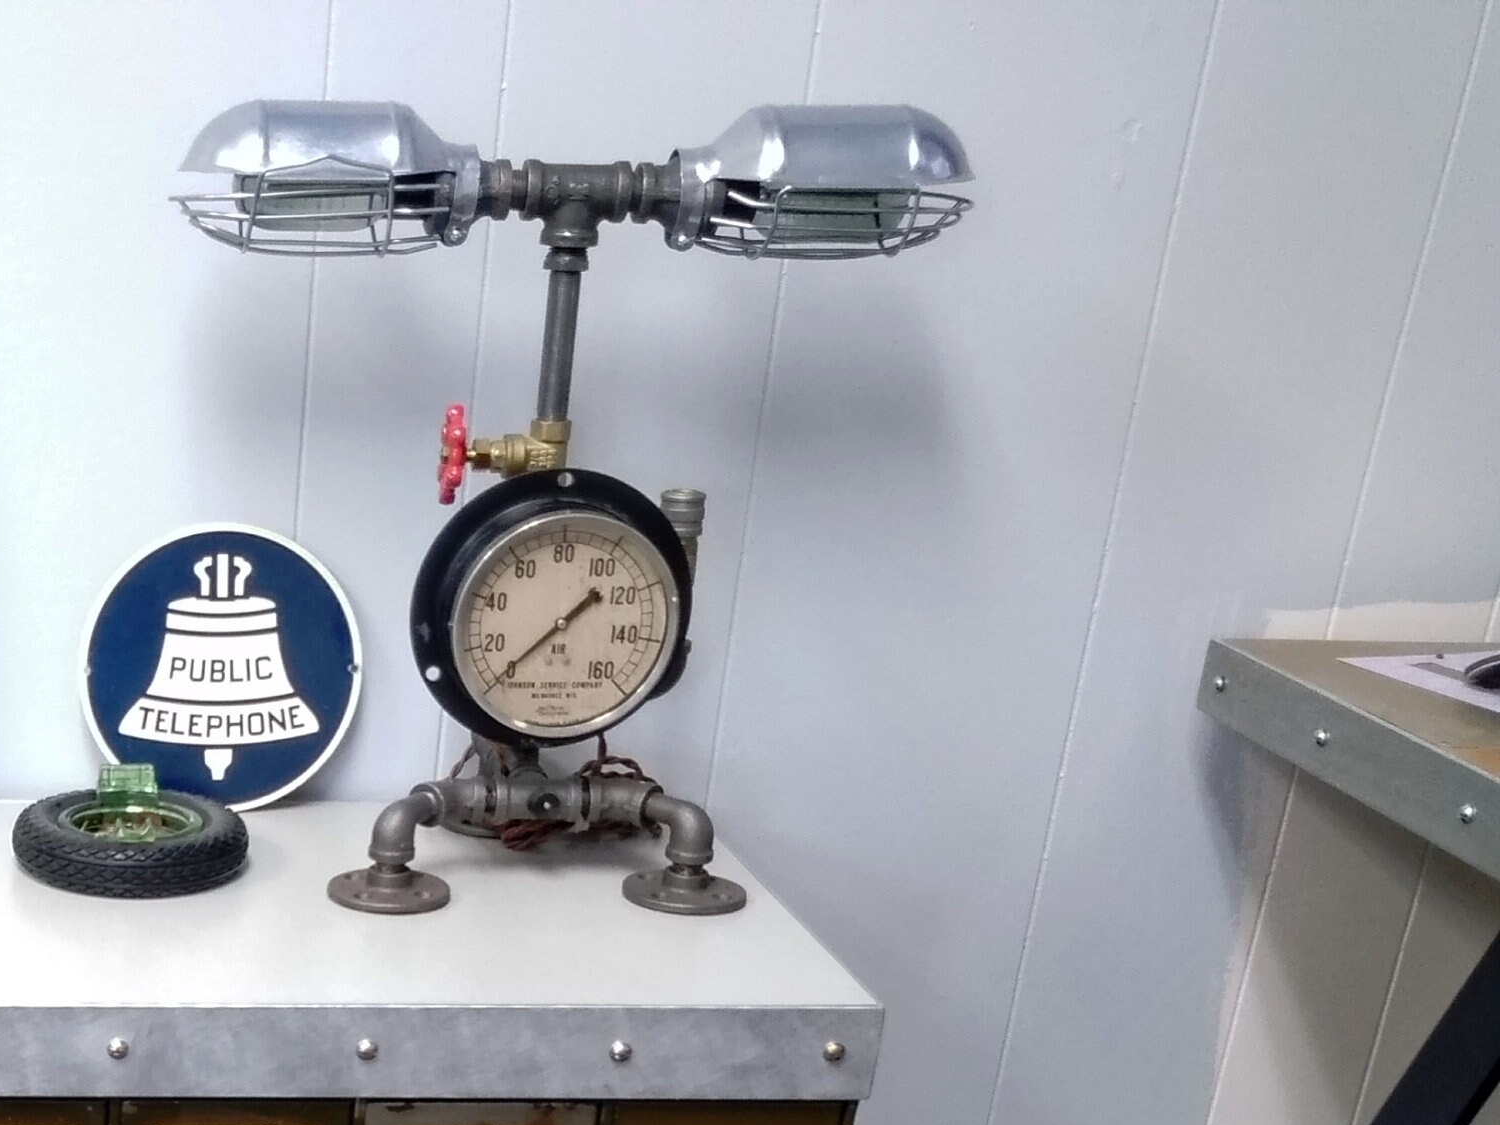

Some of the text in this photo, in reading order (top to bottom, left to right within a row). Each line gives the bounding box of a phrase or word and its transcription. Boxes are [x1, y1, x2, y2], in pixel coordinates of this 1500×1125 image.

[553, 544, 575, 563] 80
[514, 559, 536, 578] 60
[588, 558, 616, 577] 100
[485, 592, 508, 612] 40
[609, 586, 636, 605] 120
[484, 633, 505, 653] 20
[610, 625, 638, 644] 140
[550, 643, 567, 655] AIR
[169, 656, 273, 683] PUBLIC
[506, 660, 517, 679] 0
[587, 660, 615, 680] 160
[139, 705, 305, 738] TELEPHONE
